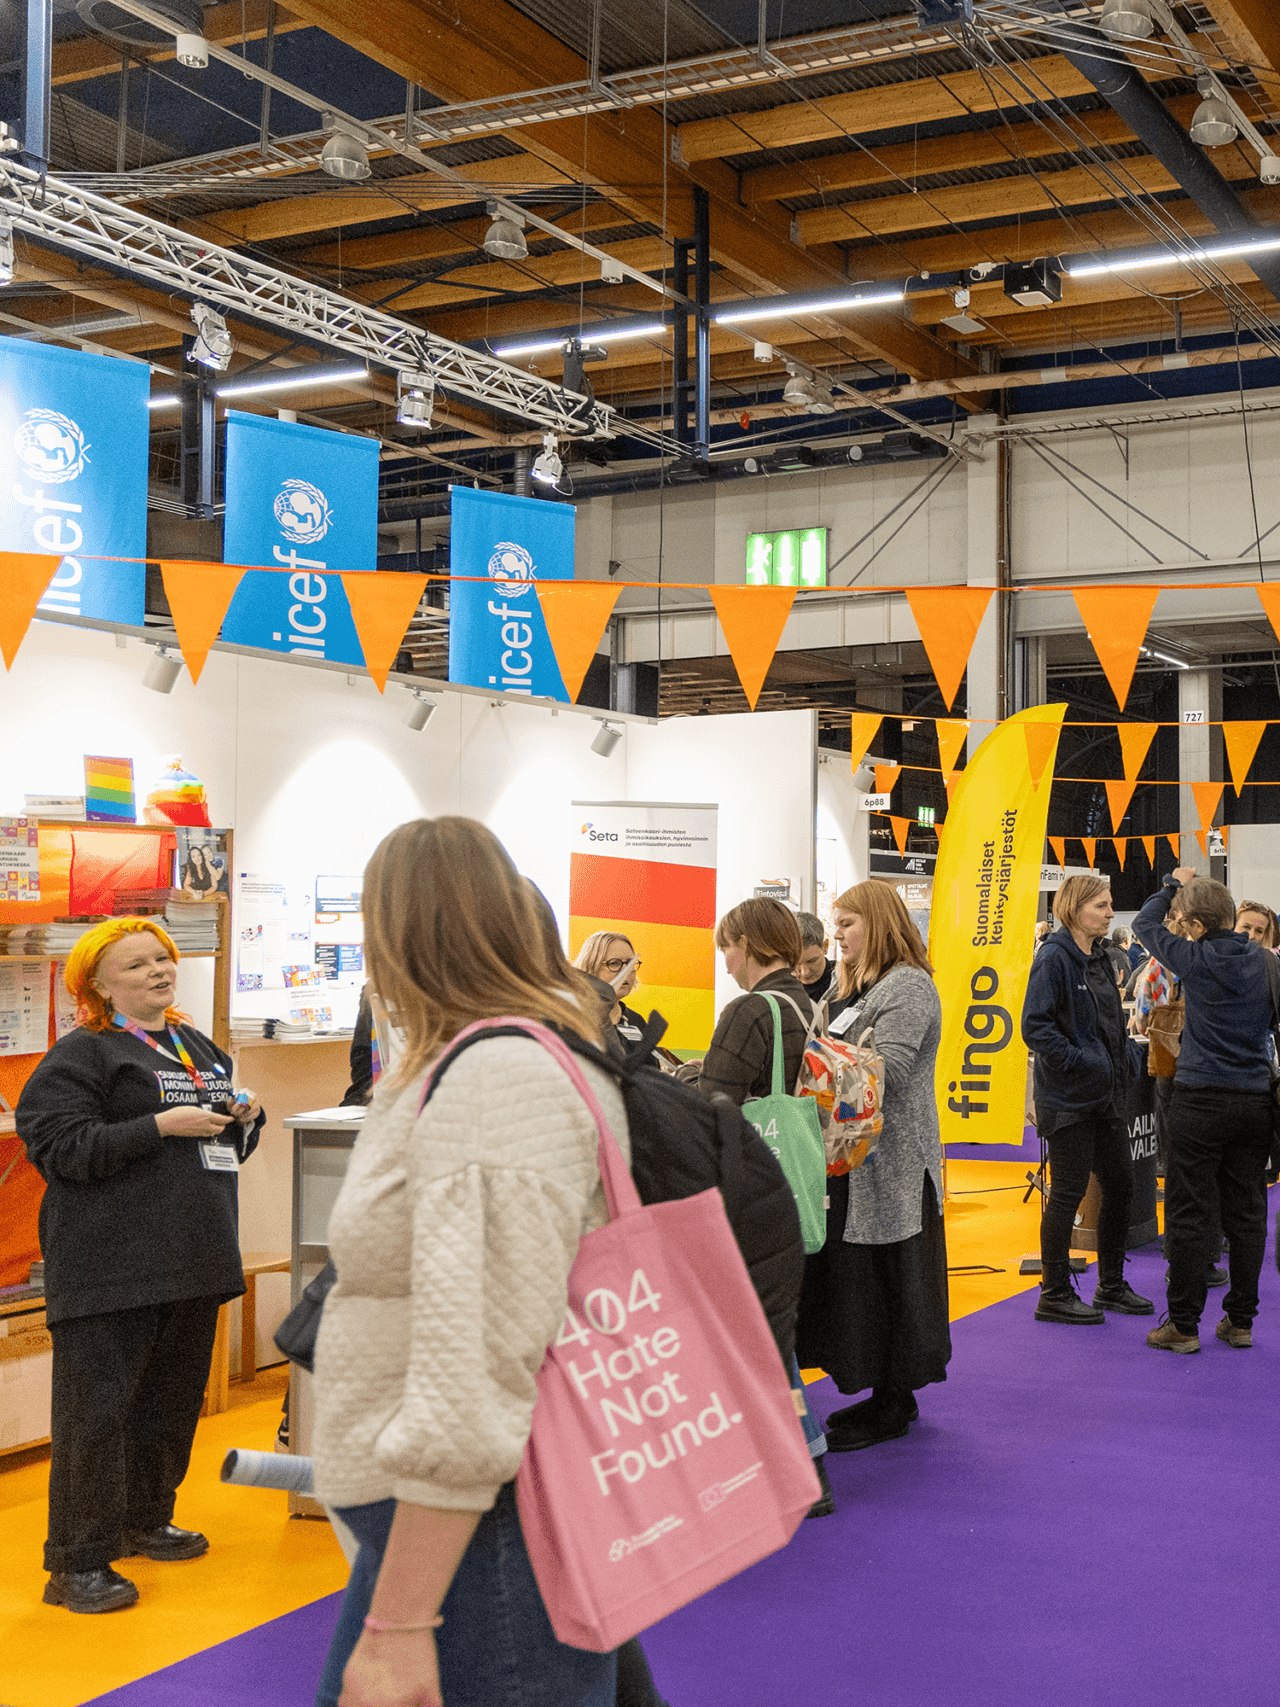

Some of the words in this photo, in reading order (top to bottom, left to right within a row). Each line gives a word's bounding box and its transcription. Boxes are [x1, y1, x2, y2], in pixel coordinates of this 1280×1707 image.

[1185, 712, 1203, 722] 727
[588, 830, 619, 842] Seta
[864, 798, 885, 807] 6p88
[971, 840, 995, 948] Suomalaiset
[988, 808, 1018, 946] kehitysjärjestöt
[946, 965, 1014, 1120] fingo
[567, 1325, 682, 1400] Hate
[599, 1370, 689, 1438] Not
[589, 1391, 744, 1497] Found.
